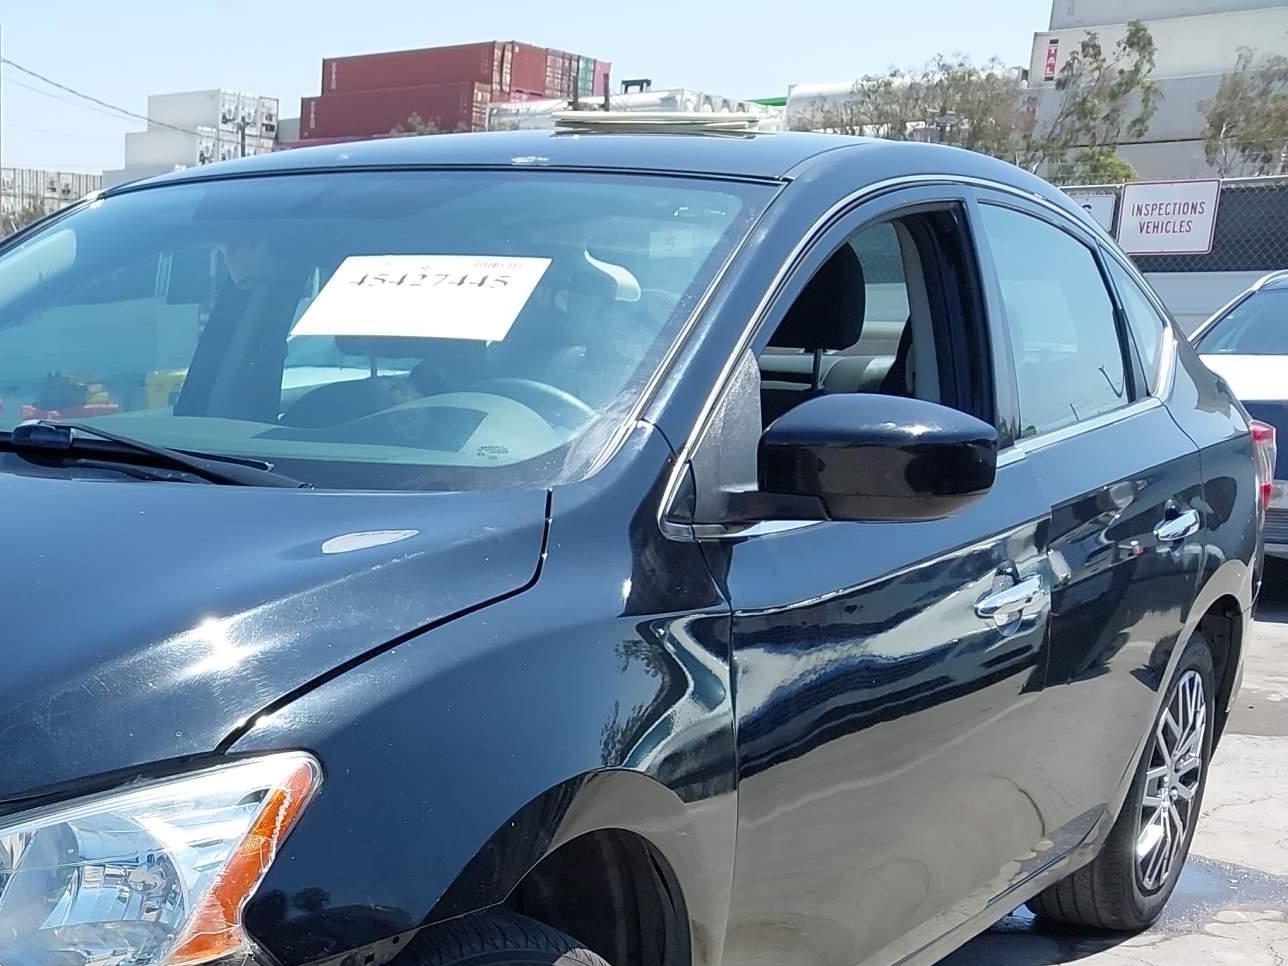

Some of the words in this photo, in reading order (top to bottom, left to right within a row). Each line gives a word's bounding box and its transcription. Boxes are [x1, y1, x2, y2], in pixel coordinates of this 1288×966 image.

[1132, 201, 1205, 216] INSPECTIONS
[1139, 220, 1192, 233] VEHICLES
[349, 273, 511, 288] 45427445
